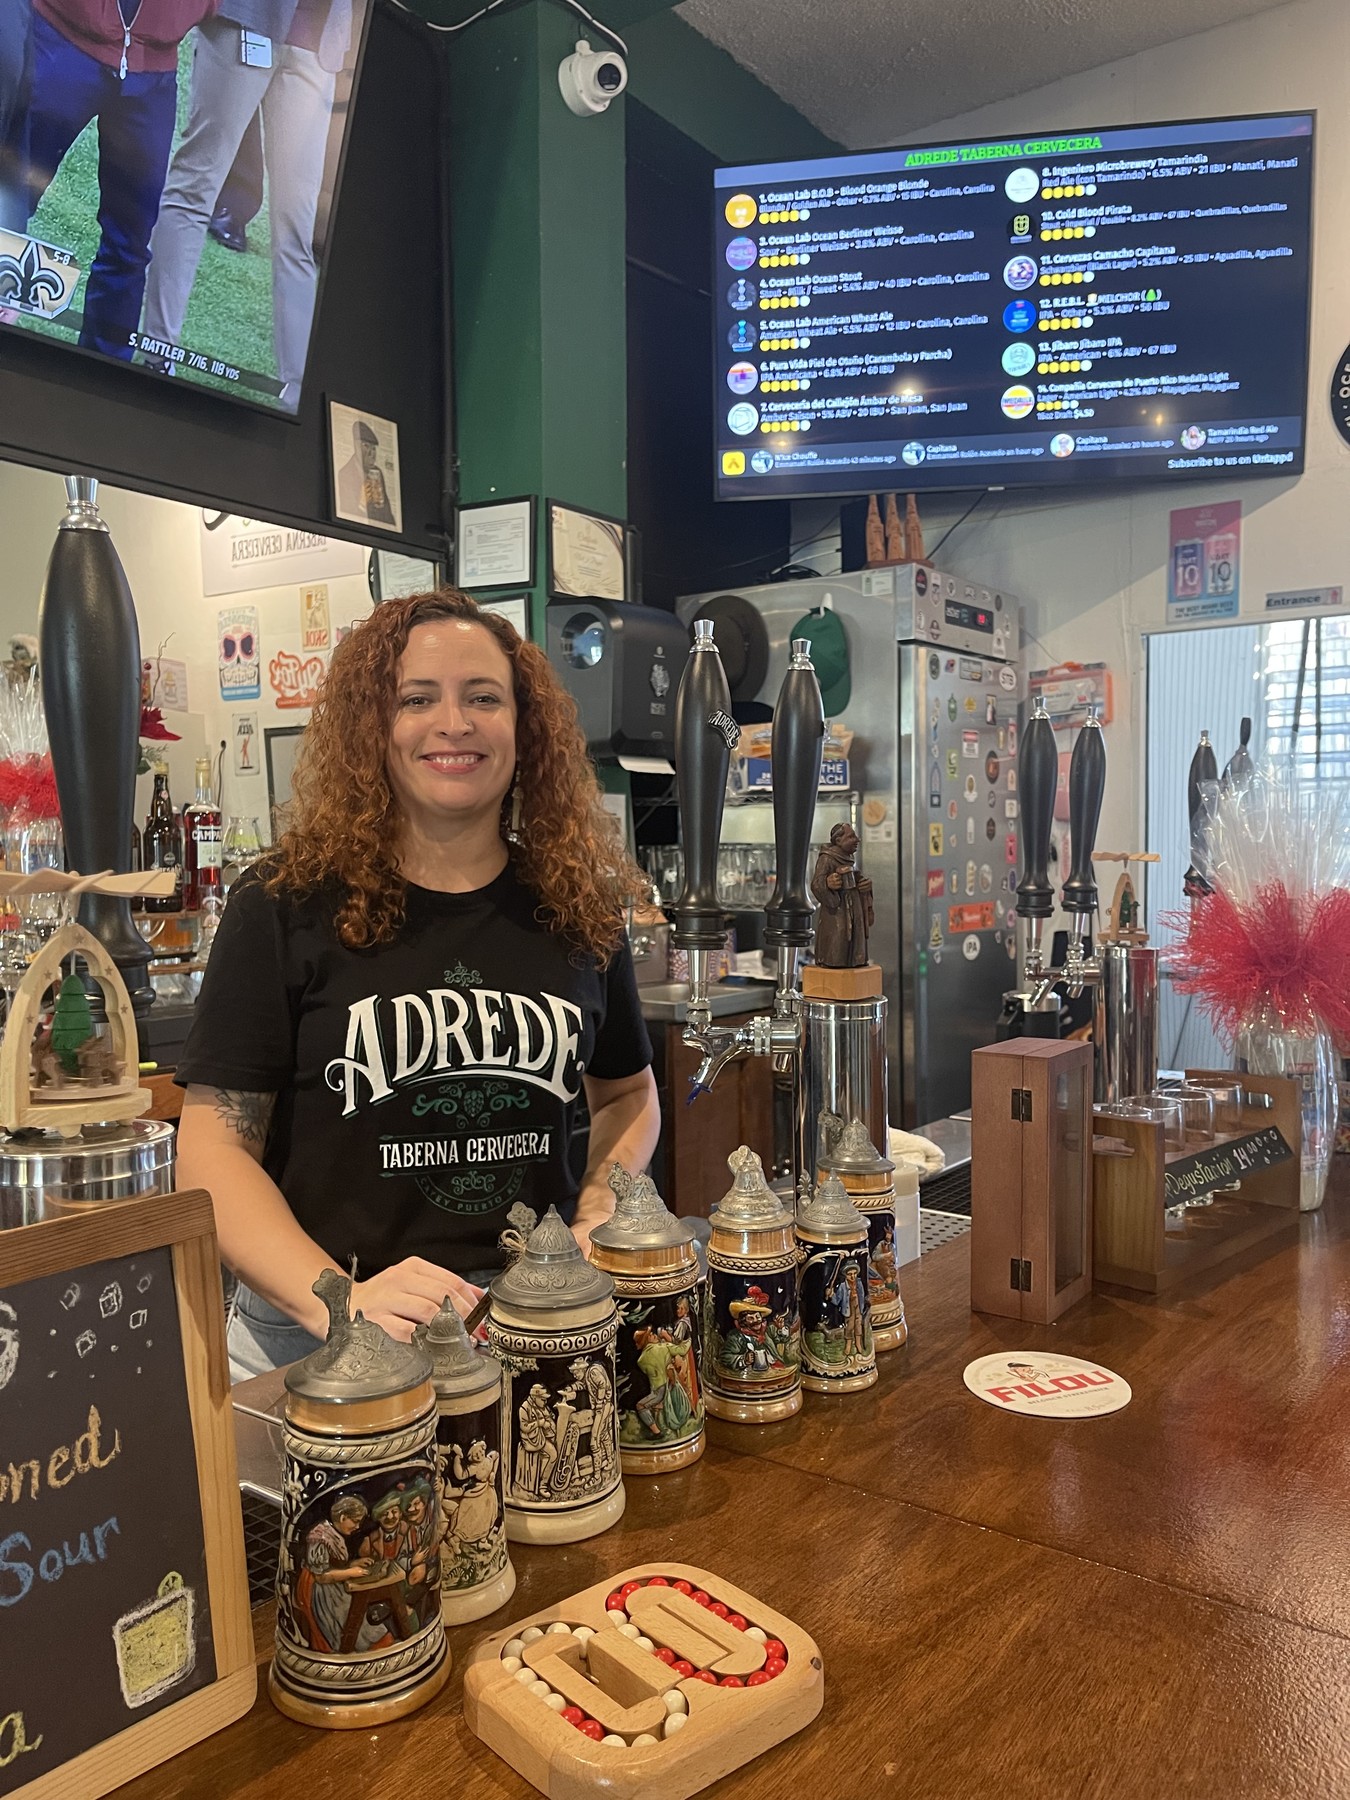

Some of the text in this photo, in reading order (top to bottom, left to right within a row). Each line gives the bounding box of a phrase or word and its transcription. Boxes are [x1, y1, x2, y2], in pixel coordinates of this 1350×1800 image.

[905, 136, 1102, 167] ADREDE TABERNA CERVECERA
[1041, 162, 1225, 187] Red Ale Tamarindo) 6.5% ABV IBU
[1052, 152, 1208, 177] Ingeniero Microbrewery Tamarindia
[767, 191, 793, 202] Ocean
[794, 189, 810, 200] Lab
[866, 181, 896, 194] Orange
[898, 178, 929, 191] Blonde
[929, 184, 994, 198] Carolina, Carolina
[1055, 203, 1132, 219] Cold Blood Pirata
[759, 230, 974, 256] Sour Berliner Weisse ABV Carolina, Carolina
[768, 233, 794, 245] Ocean
[795, 232, 811, 243] Lab
[811, 230, 838, 241] Ocean
[838, 227, 872, 239] Berliner
[873, 224, 903, 236] Weisse
[53, 250, 71, 266] 5-8
[1040, 244, 1175, 264] 11. Cervezas Camacho Capitana
[760, 271, 989, 298] Stout Sweet ABV Carolina, Carolina
[768, 276, 795, 287] Ocean
[795, 275, 811, 285] Lab
[811, 273, 838, 284] Ocean
[839, 271, 862, 282] Stout
[1039, 298, 1052, 308] 12.
[1039, 301, 1169, 319] IPA Other ABV IBU
[760, 328, 797, 339] American
[797, 326, 823, 337] Wheat
[823, 325, 837, 335] Ale
[842, 324, 862, 333] 5.5%
[863, 322, 879, 332] ABV
[895, 320, 910, 330] IBU
[916, 317, 953, 329] Carolina,
[953, 315, 988, 326] Carolina
[768, 318, 794, 329] Ocean
[795, 317, 811, 327] Lab
[811, 314, 850, 325] American
[851, 312, 878, 323] Wheat
[878, 311, 893, 321] Ale
[1038, 337, 1122, 351] 13. IPA
[1038, 344, 1176, 362] IPA American ABV IBU
[128, 332, 240, 381] S. RATTLER 7/16, 118 YDS
[769, 360, 788, 370] Pura
[789, 358, 808, 369] Vida
[808, 357, 825, 367] Piel
[864, 351, 912, 365] (Carambola
[919, 348, 952, 360] Parcha)
[761, 364, 894, 381] IPA Americana ABV IBU
[1133, 376, 1159, 387] Puerto
[1160, 375, 1177, 385] Rico
[1177, 373, 1208, 384] Medalla
[1208, 372, 1229, 383] Light
[768, 398, 810, 411] Cervecería
[811, 397, 825, 408] del
[900, 391, 923, 403] Mesa
[1062, 390, 1098, 399] American
[761, 412, 787, 422] Amber
[788, 410, 815, 420] Saison
[835, 408, 852, 417] ABV
[869, 406, 884, 415] IBU
[890, 405, 906, 414] San
[907, 403, 929, 414] Juan,
[930, 402, 946, 412] San
[947, 401, 967, 411] Juan
[1073, 408, 1094, 418] $4.50
[1207, 426, 1248, 436] Tamarindia
[926, 444, 957, 454] Capitana
[1168, 456, 1213, 468] Subscribe
[1252, 452, 1293, 464] Untappd
[1209, 561, 1232, 584] 10
[1266, 594, 1321, 608] Entrance
[708, 710, 741, 748] ADREDE
[191, 829, 223, 842] CAMPA
[965, 941, 978, 953] IPA
[324, 988, 586, 1117] ADREDE
[379, 1132, 550, 1169] TABERNA CERVECERA
[420, 1167, 524, 1212] CAYEY PUERTO RICO
[984, 1369, 1115, 1405] FILOU
[0, 1516, 121, 1608] Sour
